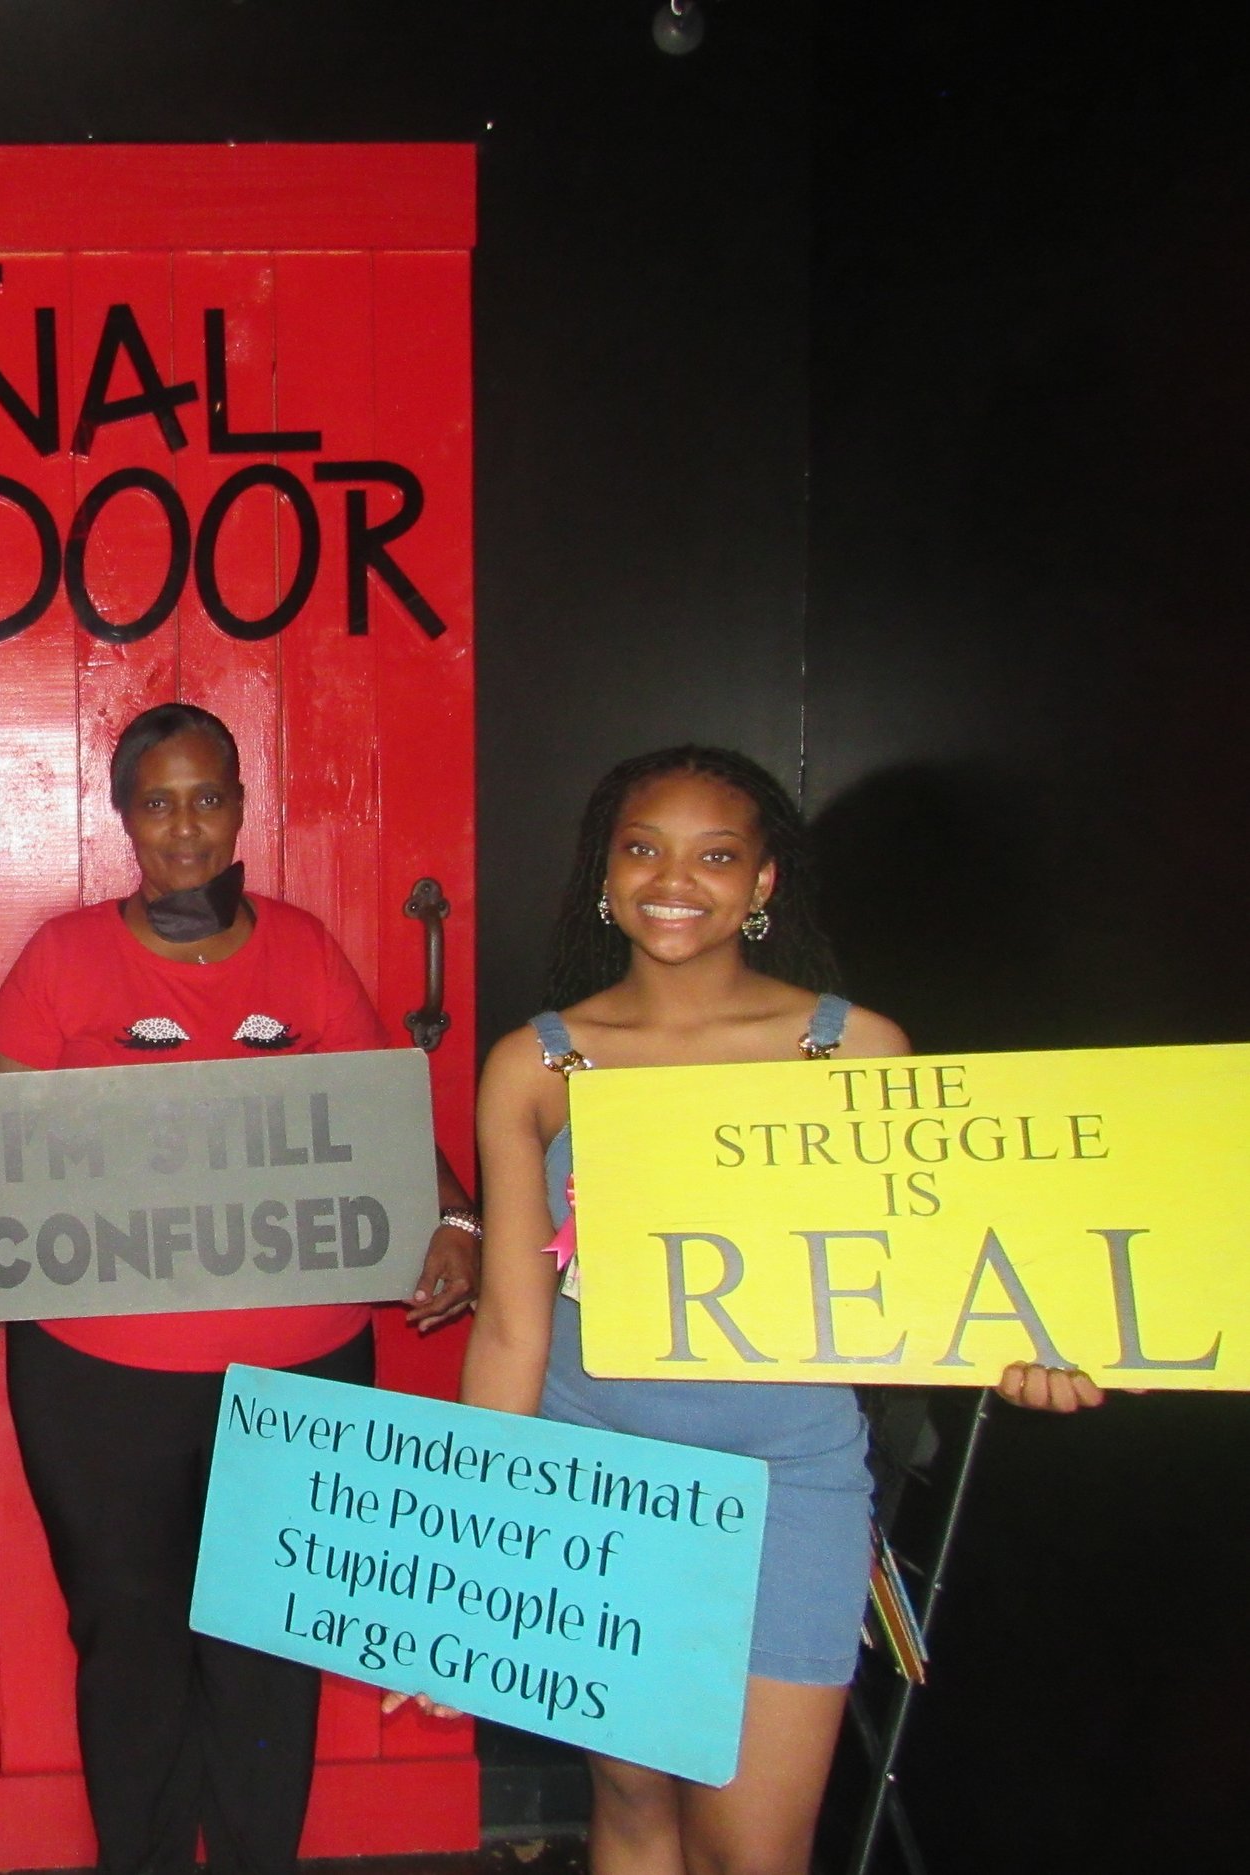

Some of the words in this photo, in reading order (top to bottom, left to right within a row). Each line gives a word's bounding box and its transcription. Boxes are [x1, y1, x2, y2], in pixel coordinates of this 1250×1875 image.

[1, 1107, 106, 1183] I'M
[150, 1091, 353, 1177] STILL
[714, 1113, 1111, 1168] STRUGGLE
[828, 1064, 973, 1113] THE
[881, 1171, 942, 1218] IS
[648, 1226, 1223, 1371] REAL
[227, 1393, 356, 1453] Never
[365, 1419, 745, 1535] Underestimate
[309, 1469, 380, 1524] the
[389, 1487, 551, 1561] Power
[562, 1529, 625, 1577] of
[274, 1526, 420, 1598] Stupid
[426, 1561, 585, 1641] People
[597, 1600, 642, 1657] in
[282, 1592, 417, 1671] Large
[429, 1632, 610, 1721] Groups
